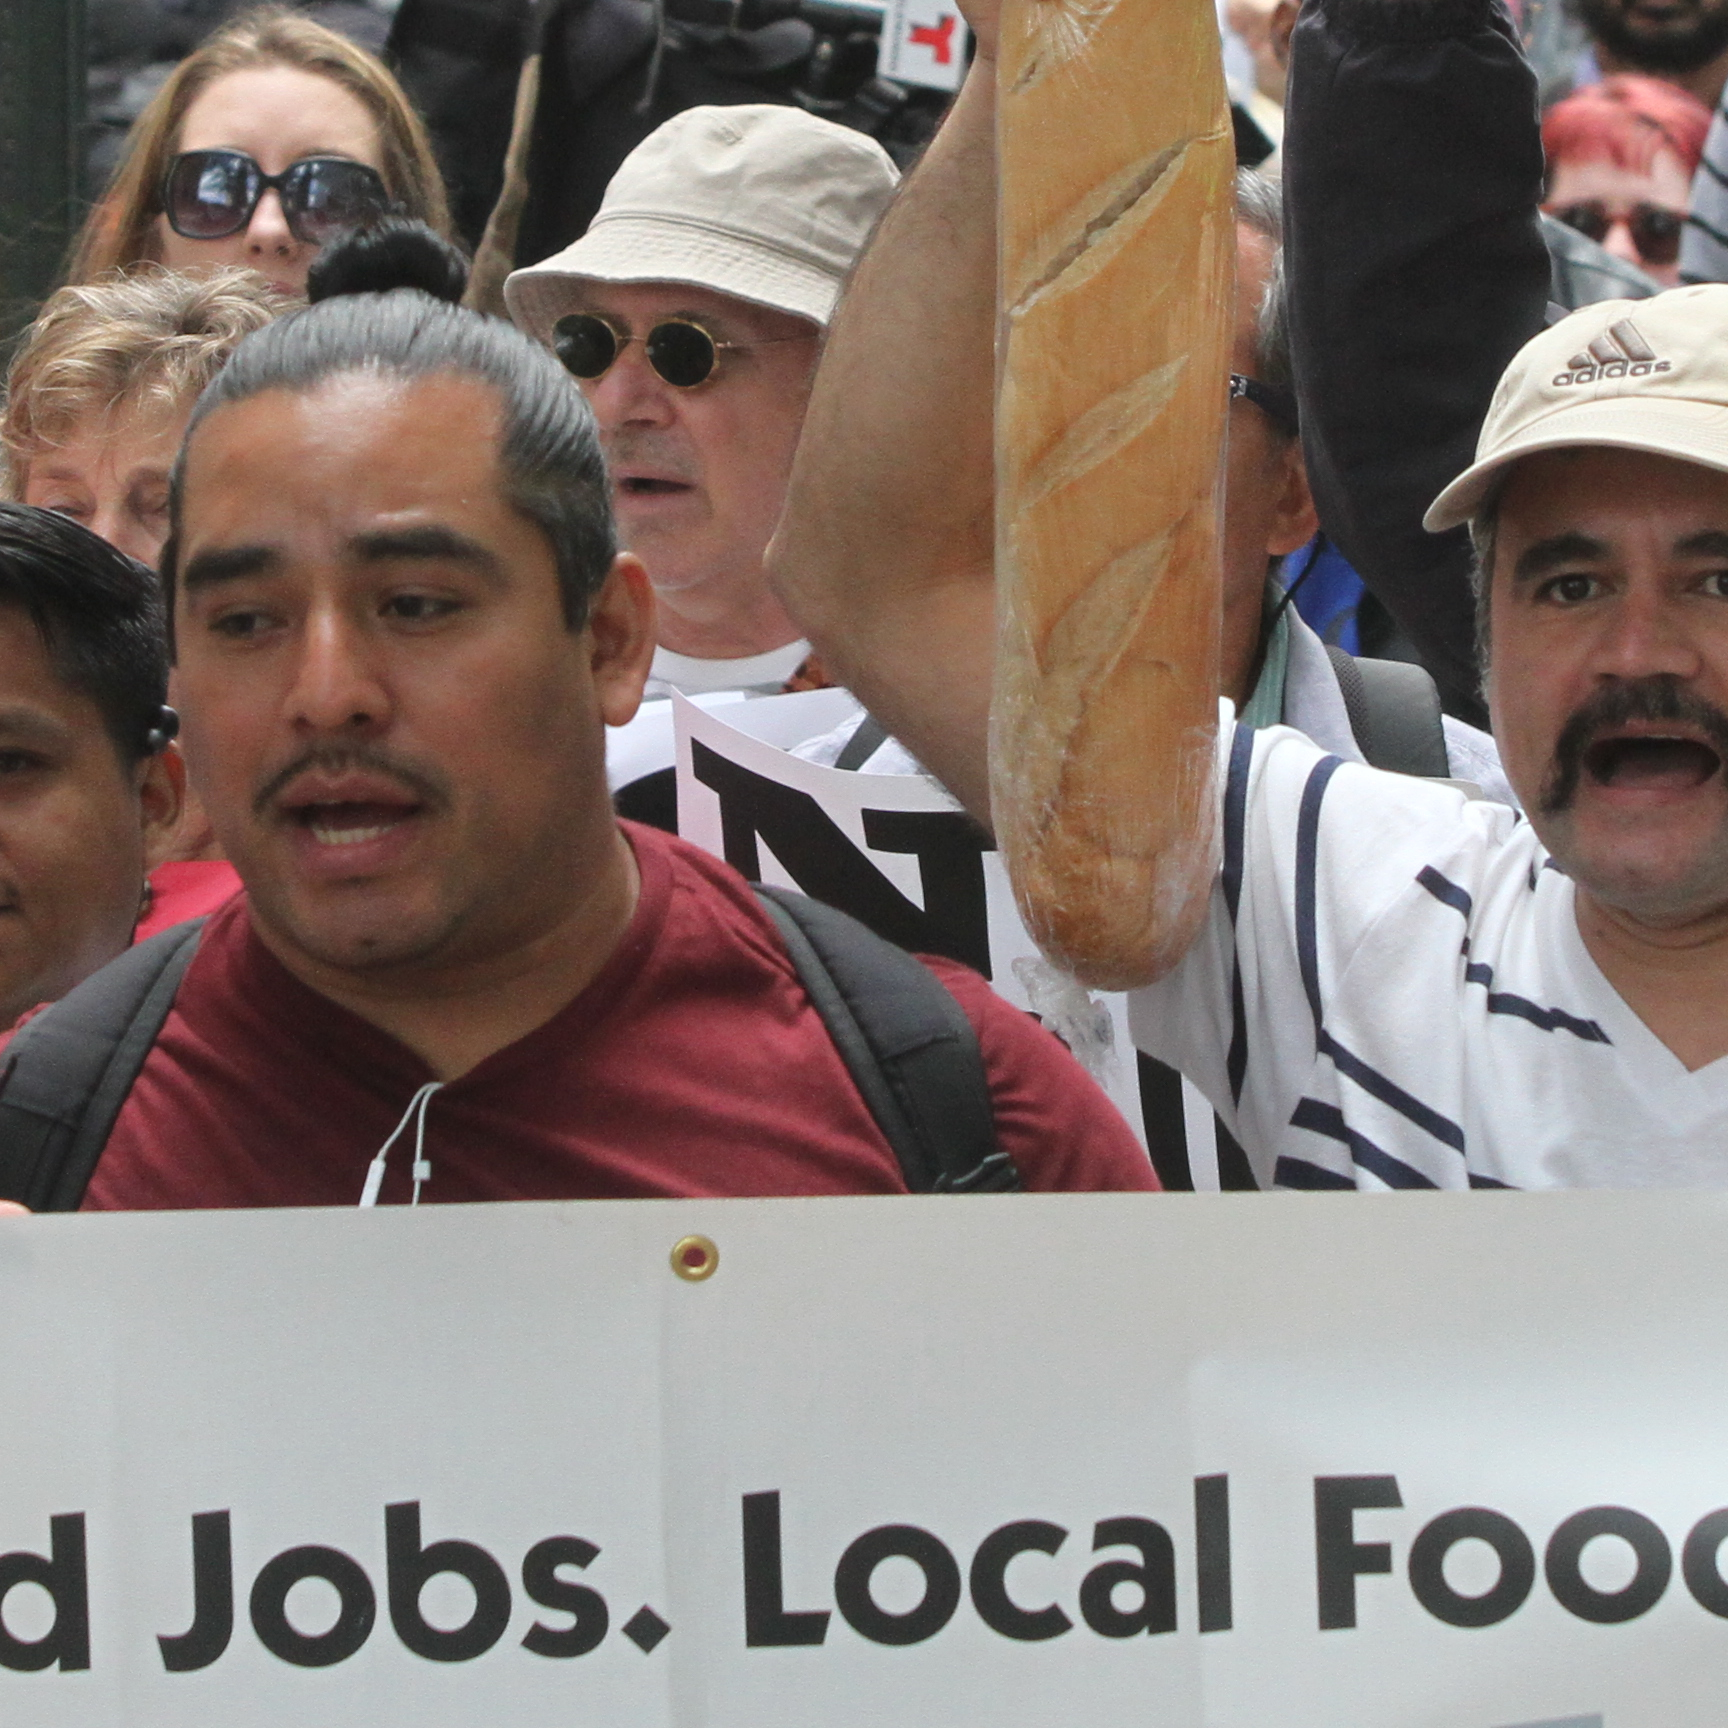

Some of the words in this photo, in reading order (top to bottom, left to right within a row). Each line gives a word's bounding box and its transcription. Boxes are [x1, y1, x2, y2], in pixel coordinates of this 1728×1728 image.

[1552, 358, 1672, 387] adidas
[154, 1499, 673, 1675] Jobs.
[740, 1471, 1234, 1649] Local
